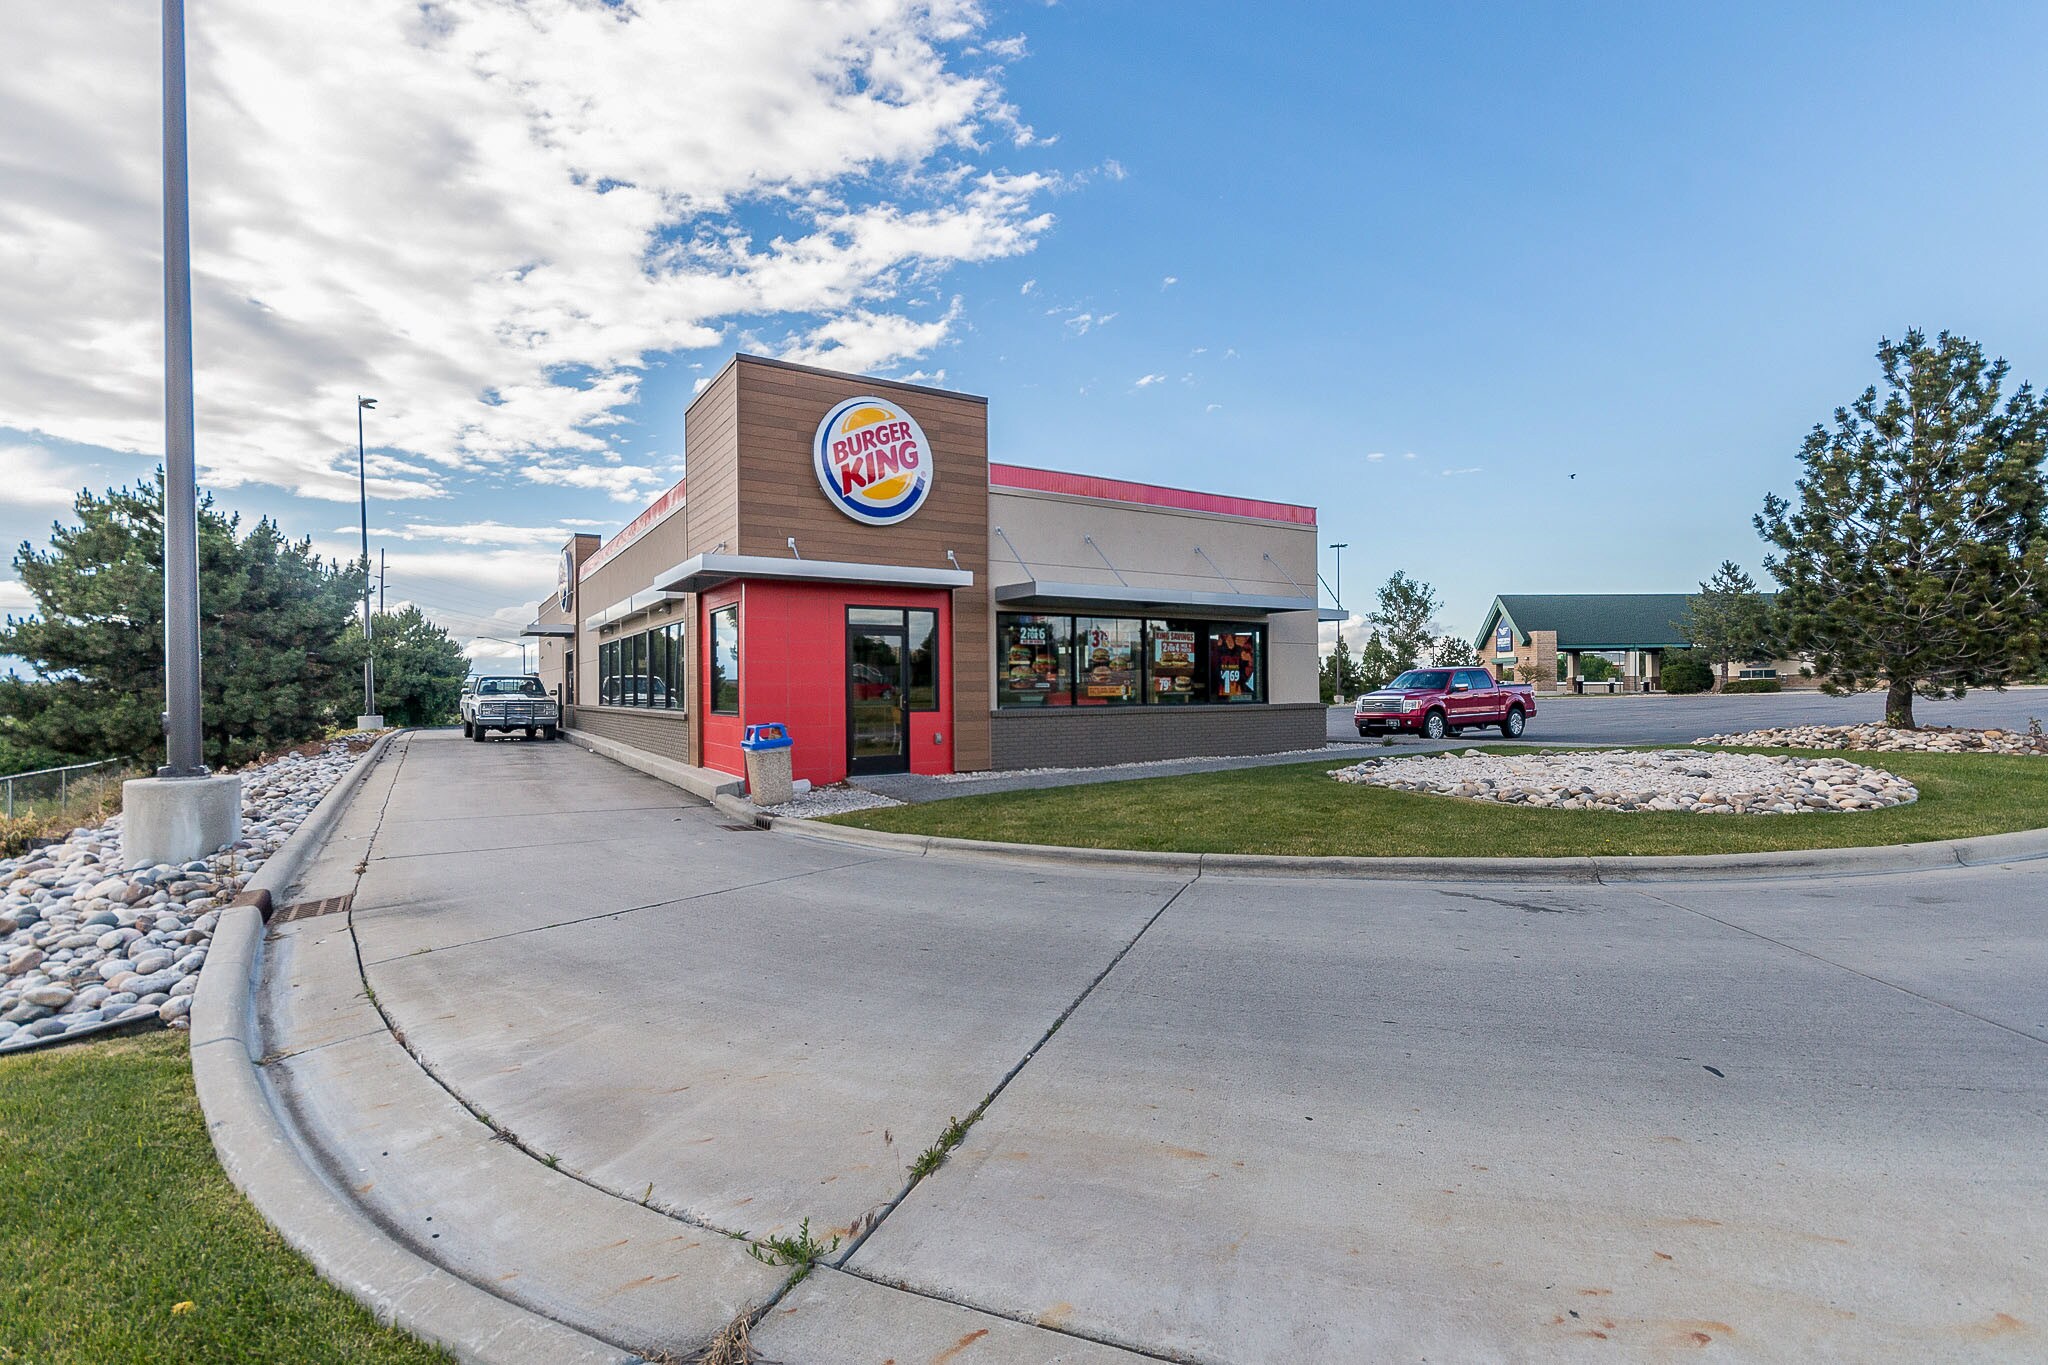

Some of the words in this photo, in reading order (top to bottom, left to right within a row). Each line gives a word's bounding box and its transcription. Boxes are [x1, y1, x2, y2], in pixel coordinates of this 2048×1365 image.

[833, 421, 912, 465] BURGER
[840, 440, 919, 496] KING
[1020, 627, 1027, 639] 2
[1039, 627, 1046, 639] 6
[1156, 632, 1169, 640] KING
[1170, 632, 1194, 641] SAVINGS
[1162, 642, 1168, 652] 2
